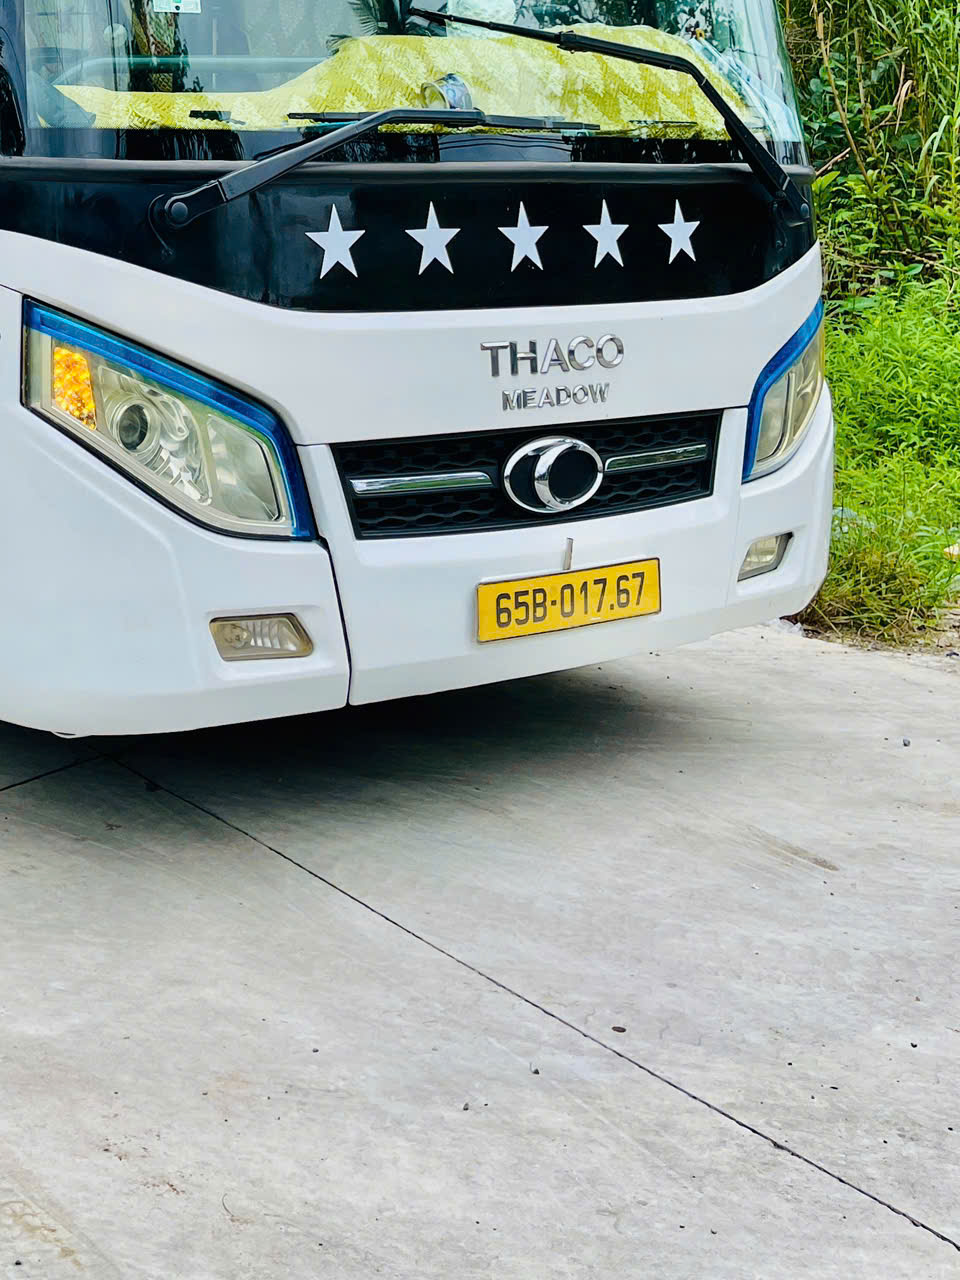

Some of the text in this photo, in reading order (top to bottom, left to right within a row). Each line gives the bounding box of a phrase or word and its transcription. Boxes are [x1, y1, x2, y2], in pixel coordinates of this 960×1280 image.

[480, 333, 625, 378] THACO
[501, 382, 611, 412] MEADOW
[495, 571, 646, 629] 65B-017.67
